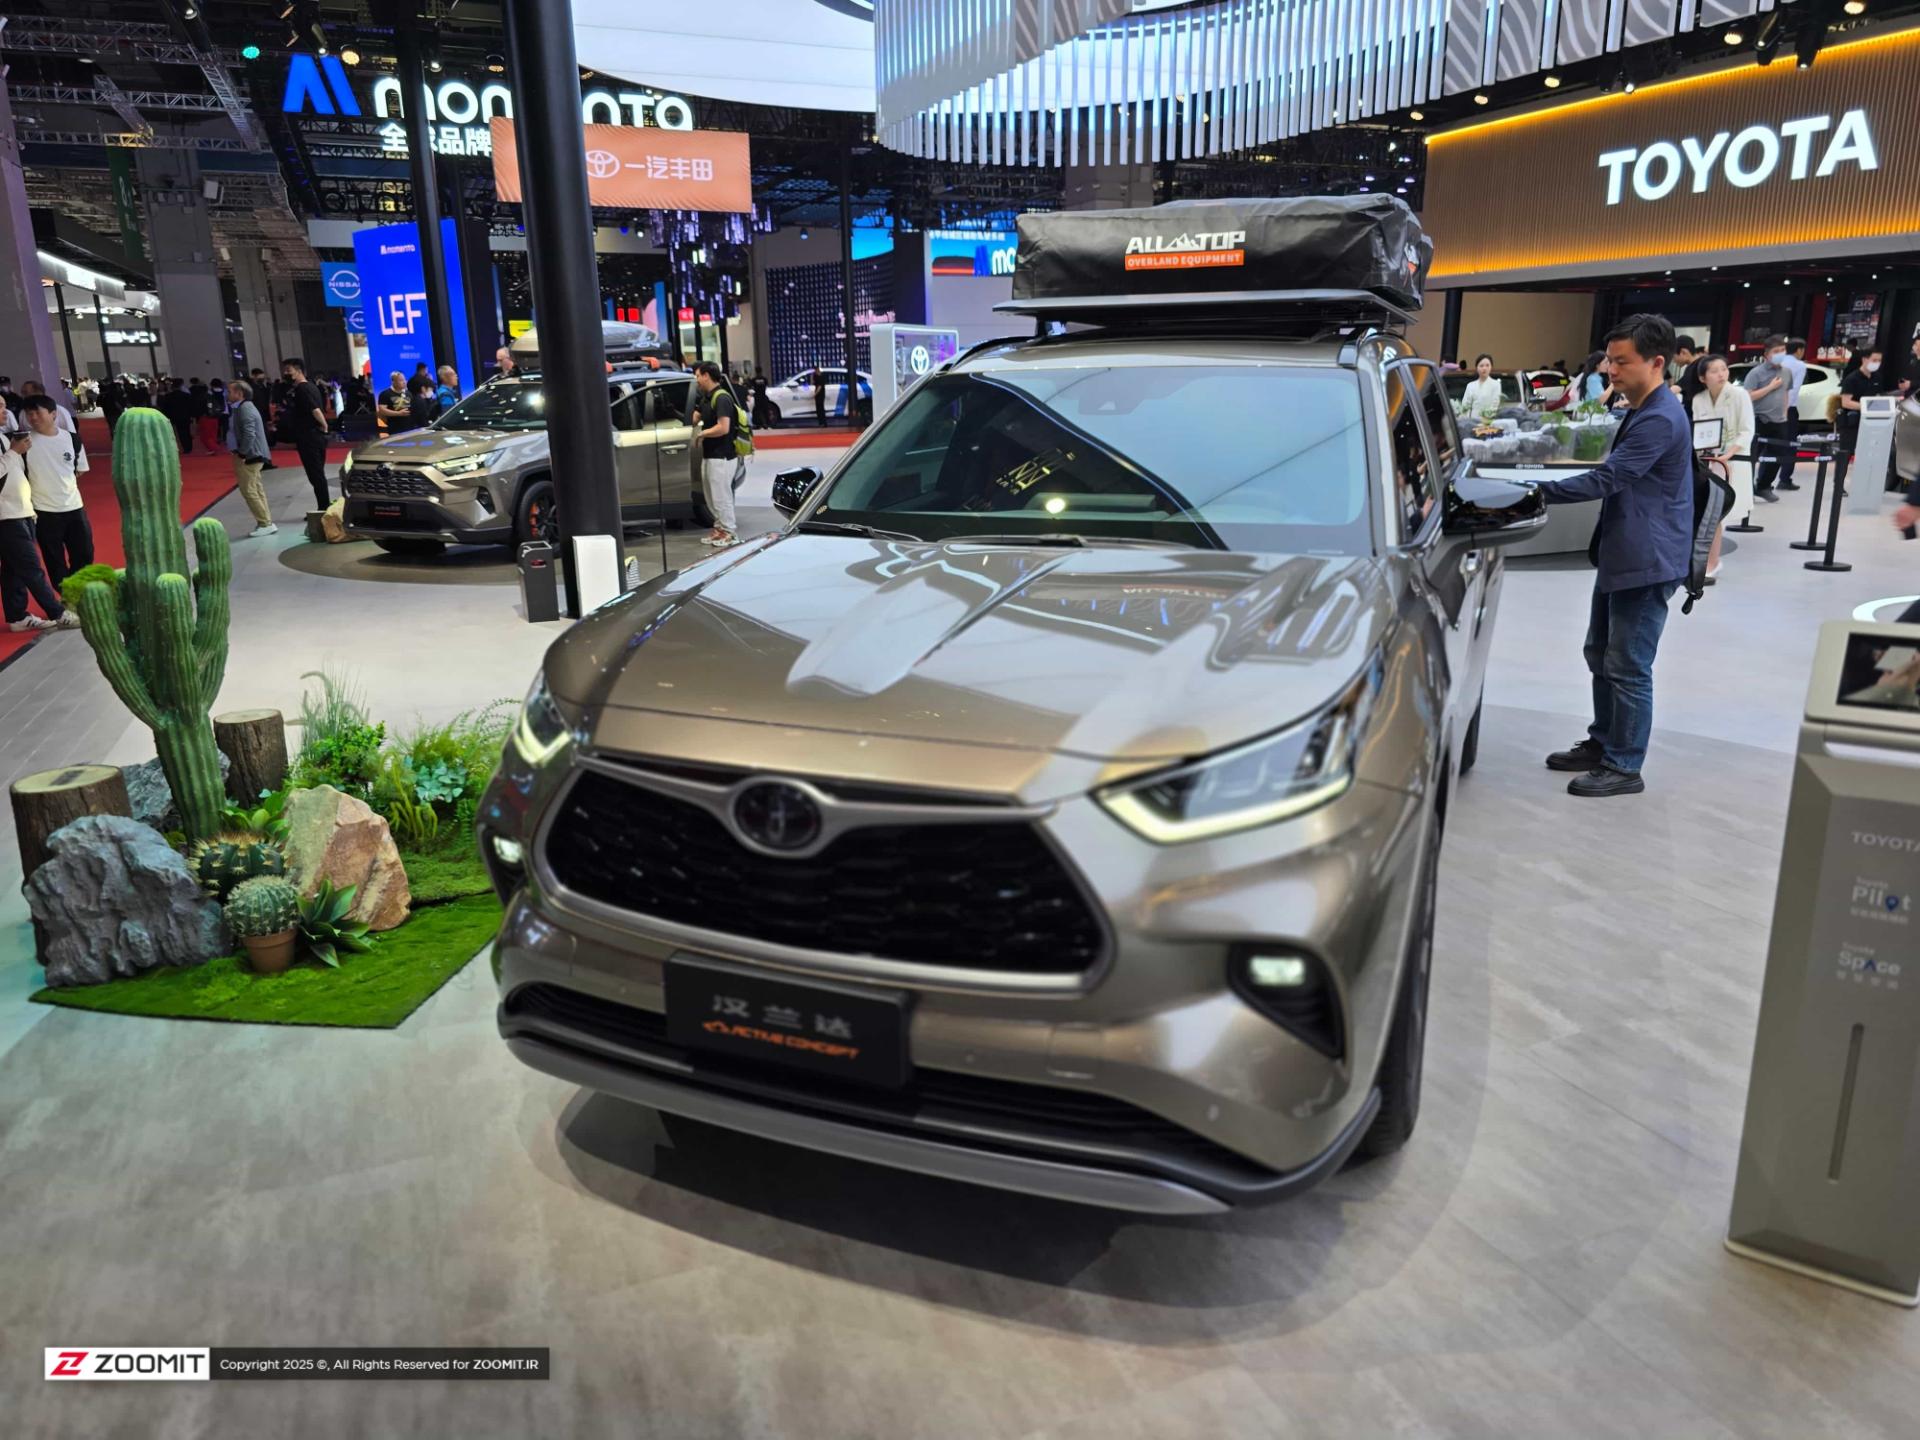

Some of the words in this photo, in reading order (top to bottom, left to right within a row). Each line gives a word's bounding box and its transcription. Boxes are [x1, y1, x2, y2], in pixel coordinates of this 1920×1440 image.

[374, 77, 694, 131] momnta
[379, 122, 493, 156] 全品牌
[624, 155, 714, 181] 一汽丰田
[1598, 109, 1879, 205] TOYOTA
[1127, 256, 1180, 268] OVERLAND
[1181, 253, 1241, 266] EQUIPMENT
[104, 331, 158, 344] BYD
